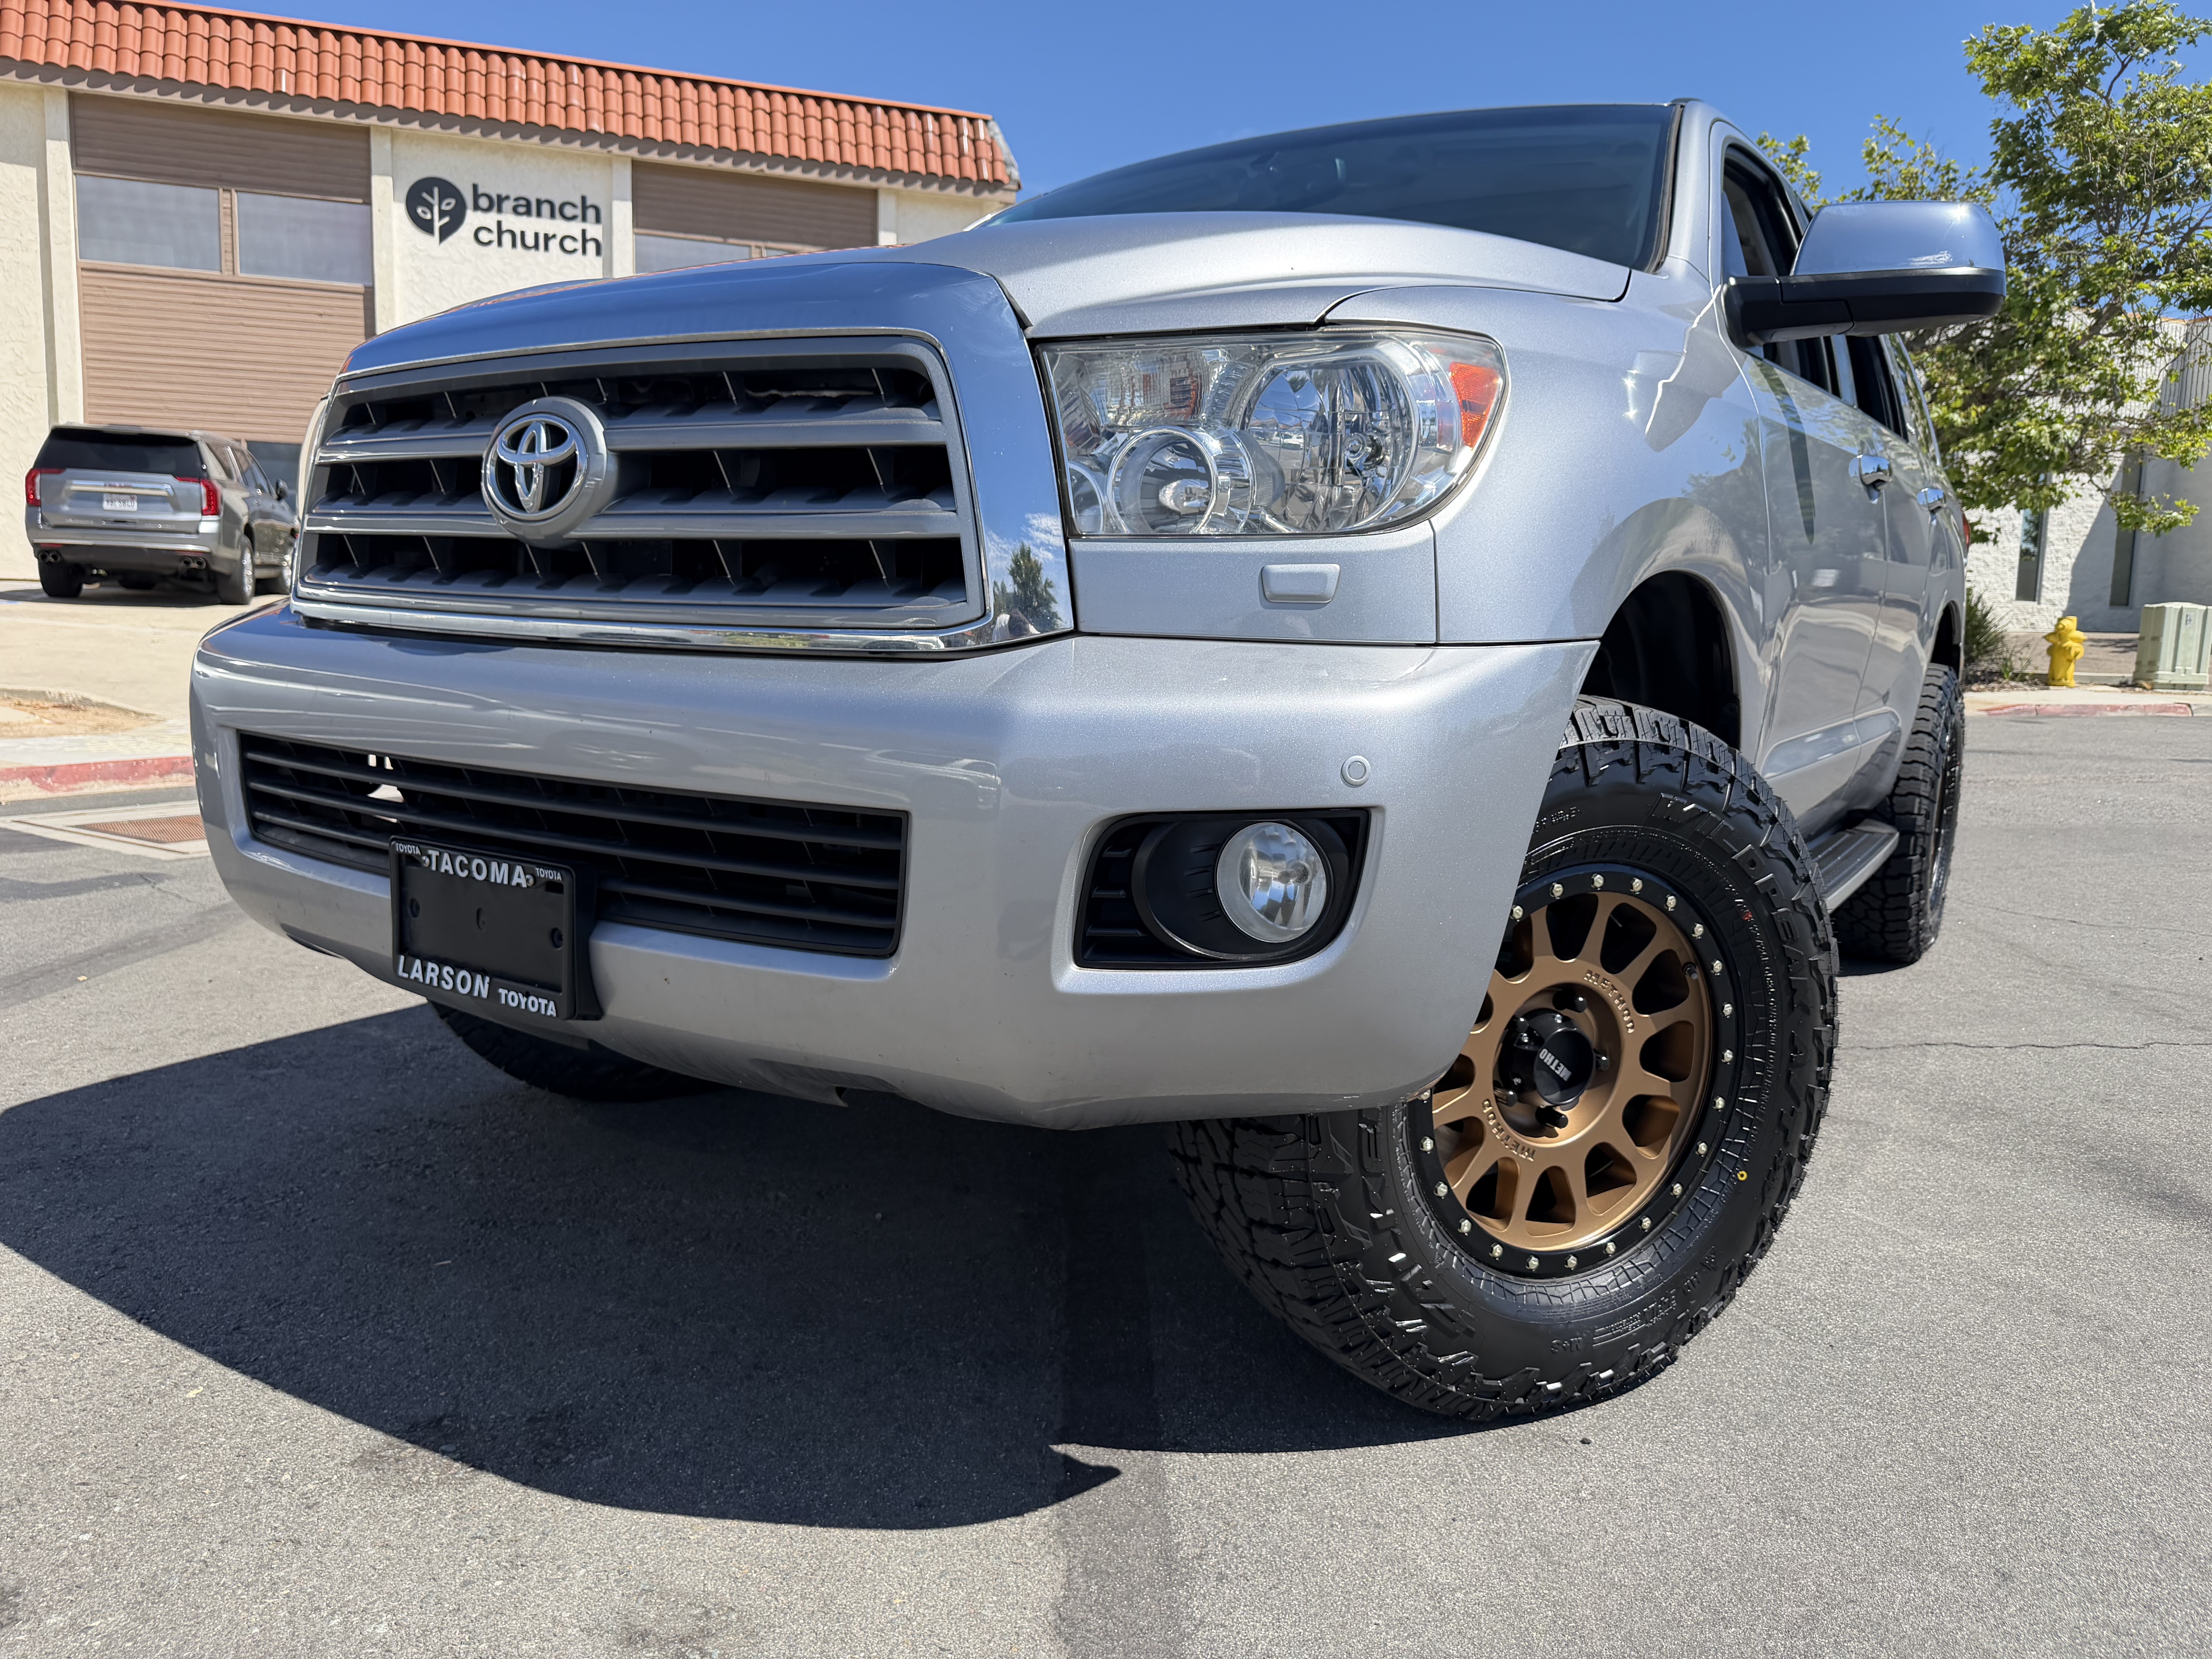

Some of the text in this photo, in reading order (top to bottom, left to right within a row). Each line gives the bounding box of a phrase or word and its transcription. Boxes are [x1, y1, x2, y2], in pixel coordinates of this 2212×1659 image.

[472, 183, 601, 224] branch
[473, 220, 602, 257] church
[395, 842, 421, 855] TOYOTA
[428, 849, 527, 888] TACOMA
[535, 867, 562, 881] TOYOTA
[397, 955, 556, 1017] LARSON TOYOTA
[1584, 969, 1635, 1034] METHOD
[1482, 1098, 1535, 1162] METHOD
